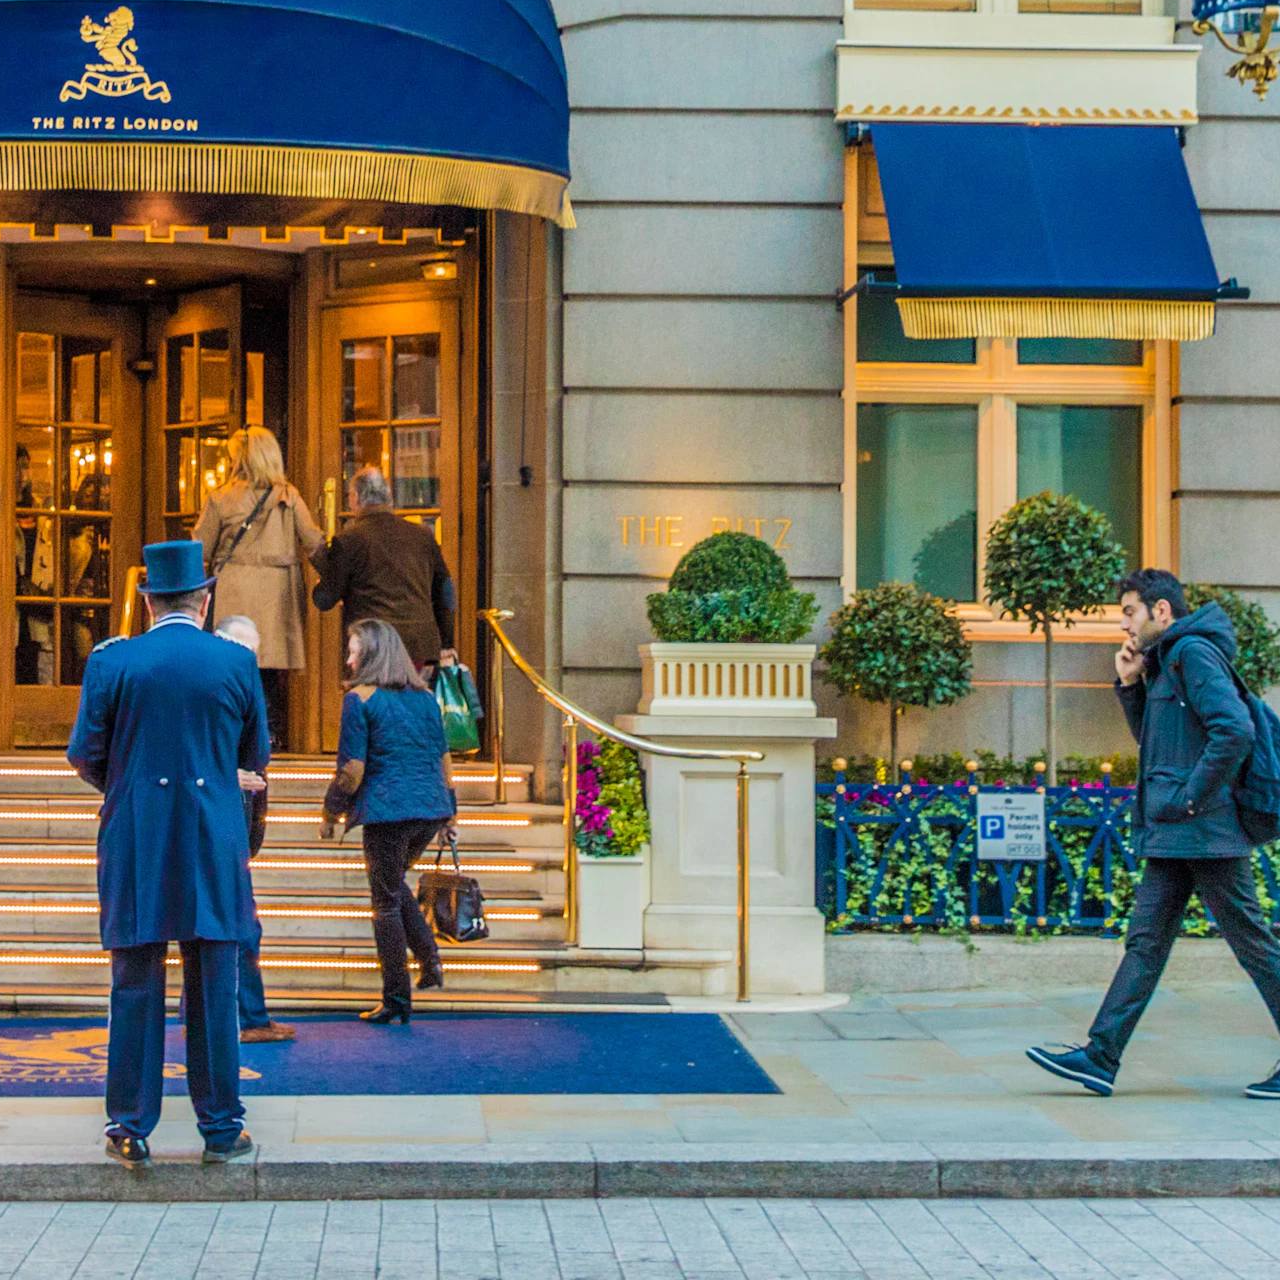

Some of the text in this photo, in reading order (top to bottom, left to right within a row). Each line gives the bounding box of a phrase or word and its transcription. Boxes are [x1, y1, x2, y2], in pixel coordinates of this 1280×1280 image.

[97, 78, 135, 93] RITZ
[32, 117, 199, 131] THE RITZ LONDON
[616, 515, 684, 547] THE
[1009, 813, 1039, 821] Permit
[986, 818, 1001, 837] P
